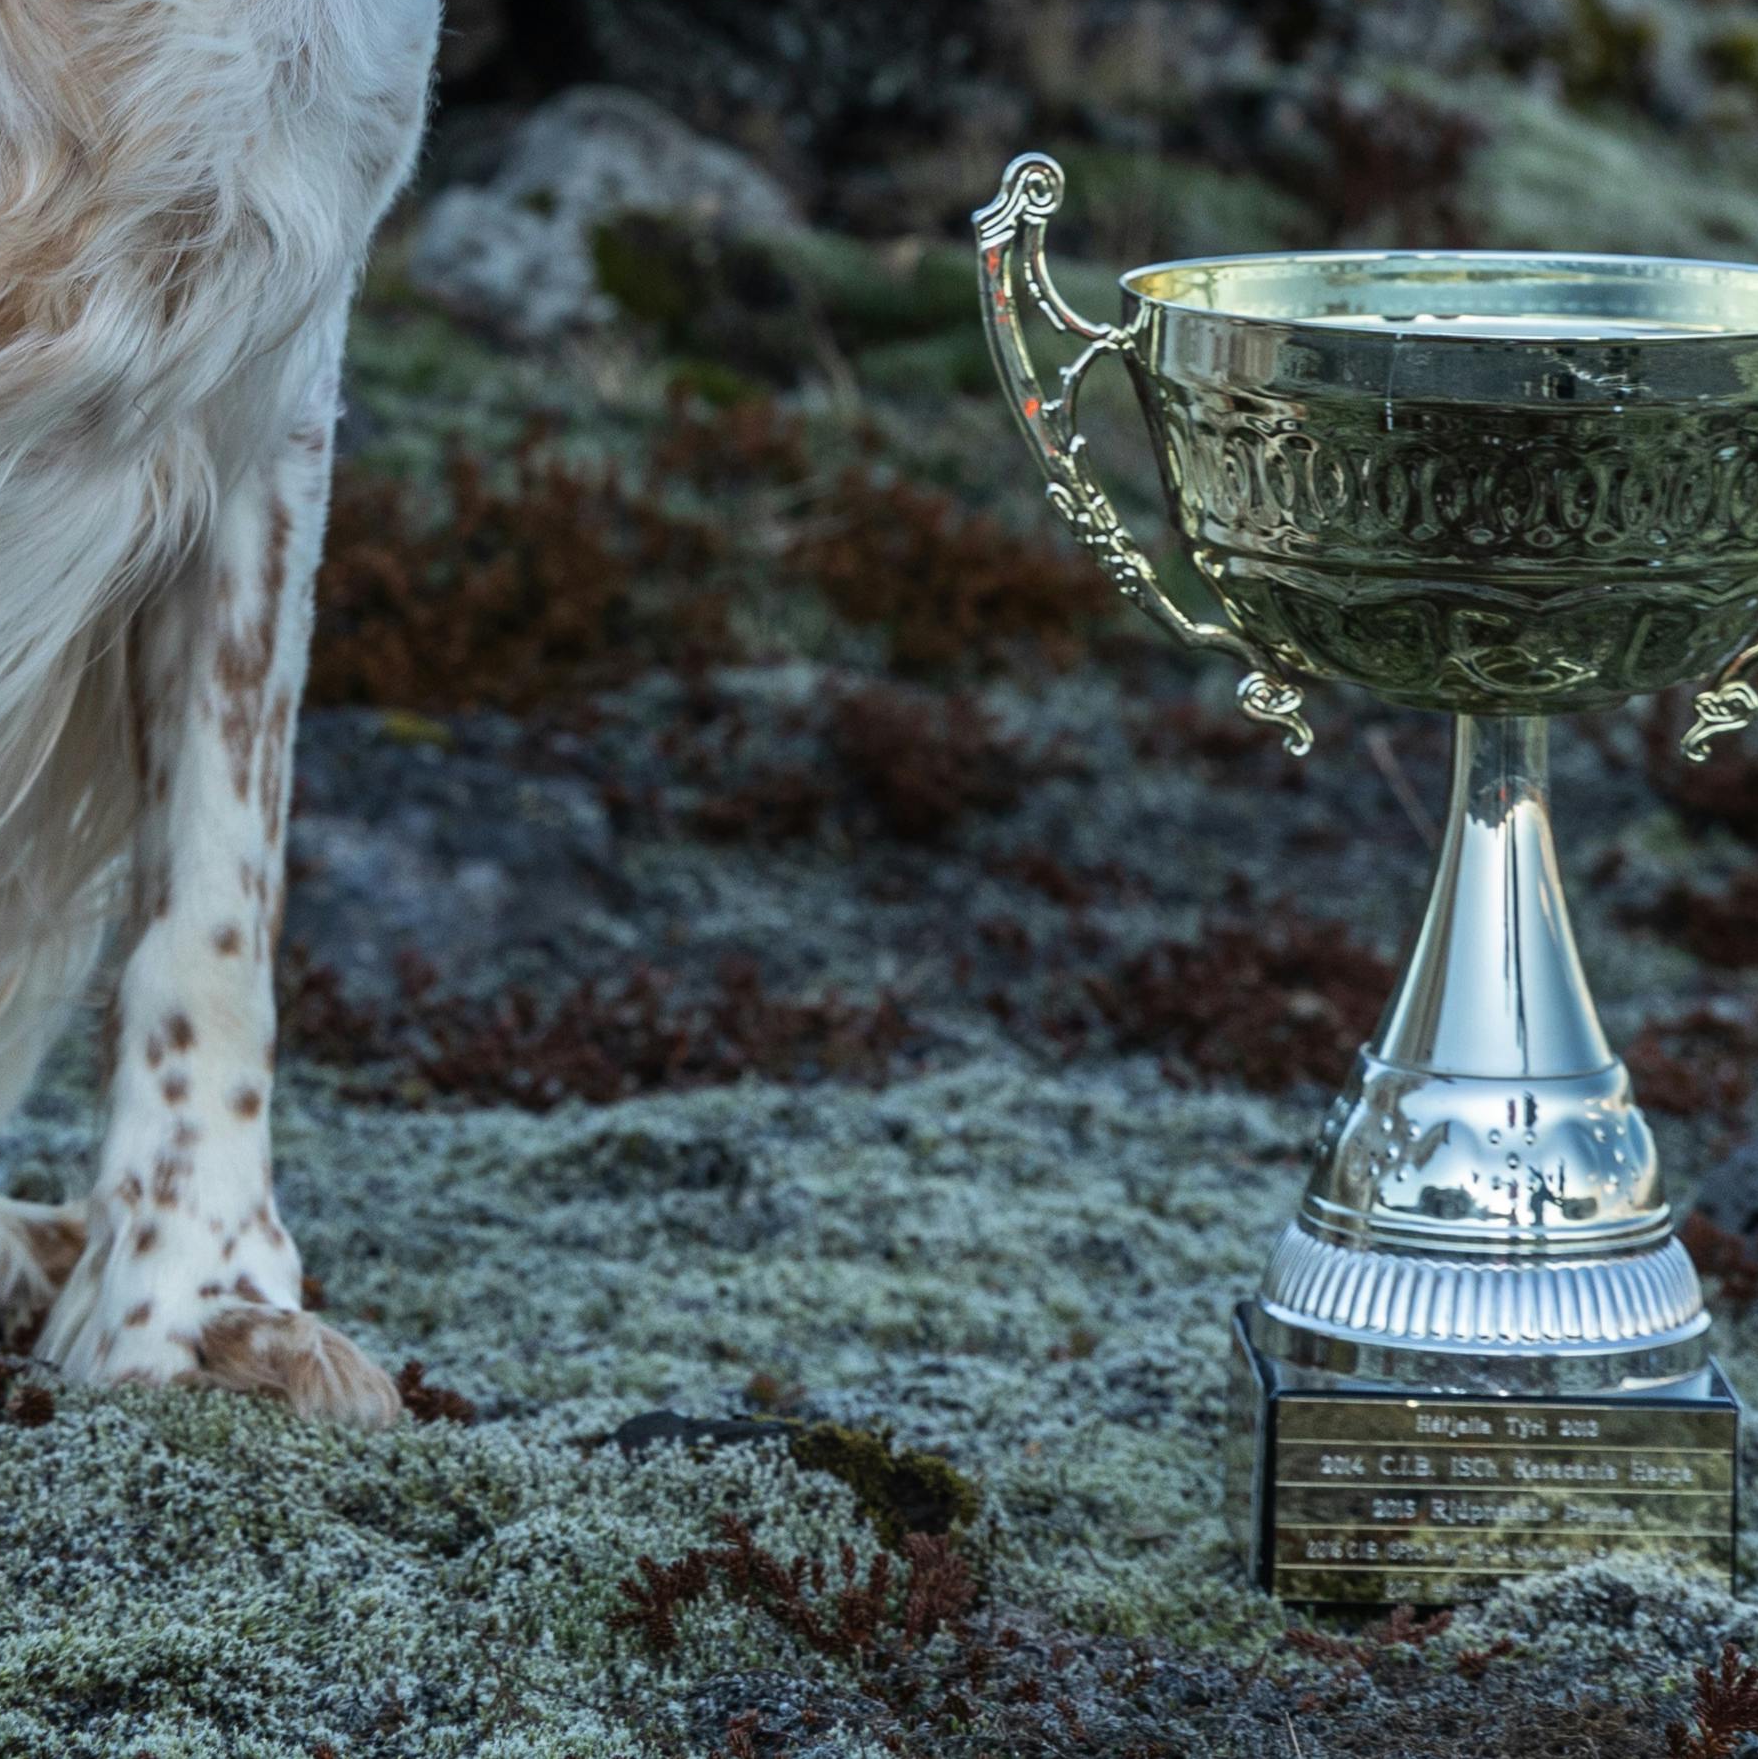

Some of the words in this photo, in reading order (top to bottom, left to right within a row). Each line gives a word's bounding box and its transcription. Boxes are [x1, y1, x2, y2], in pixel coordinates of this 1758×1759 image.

[1503, 1415, 1548, 1440] Týri
[1319, 1454, 1366, 1475] 2014
[1378, 1454, 1436, 1478] C.I.B.
[1371, 1498, 1417, 1519] 2015
